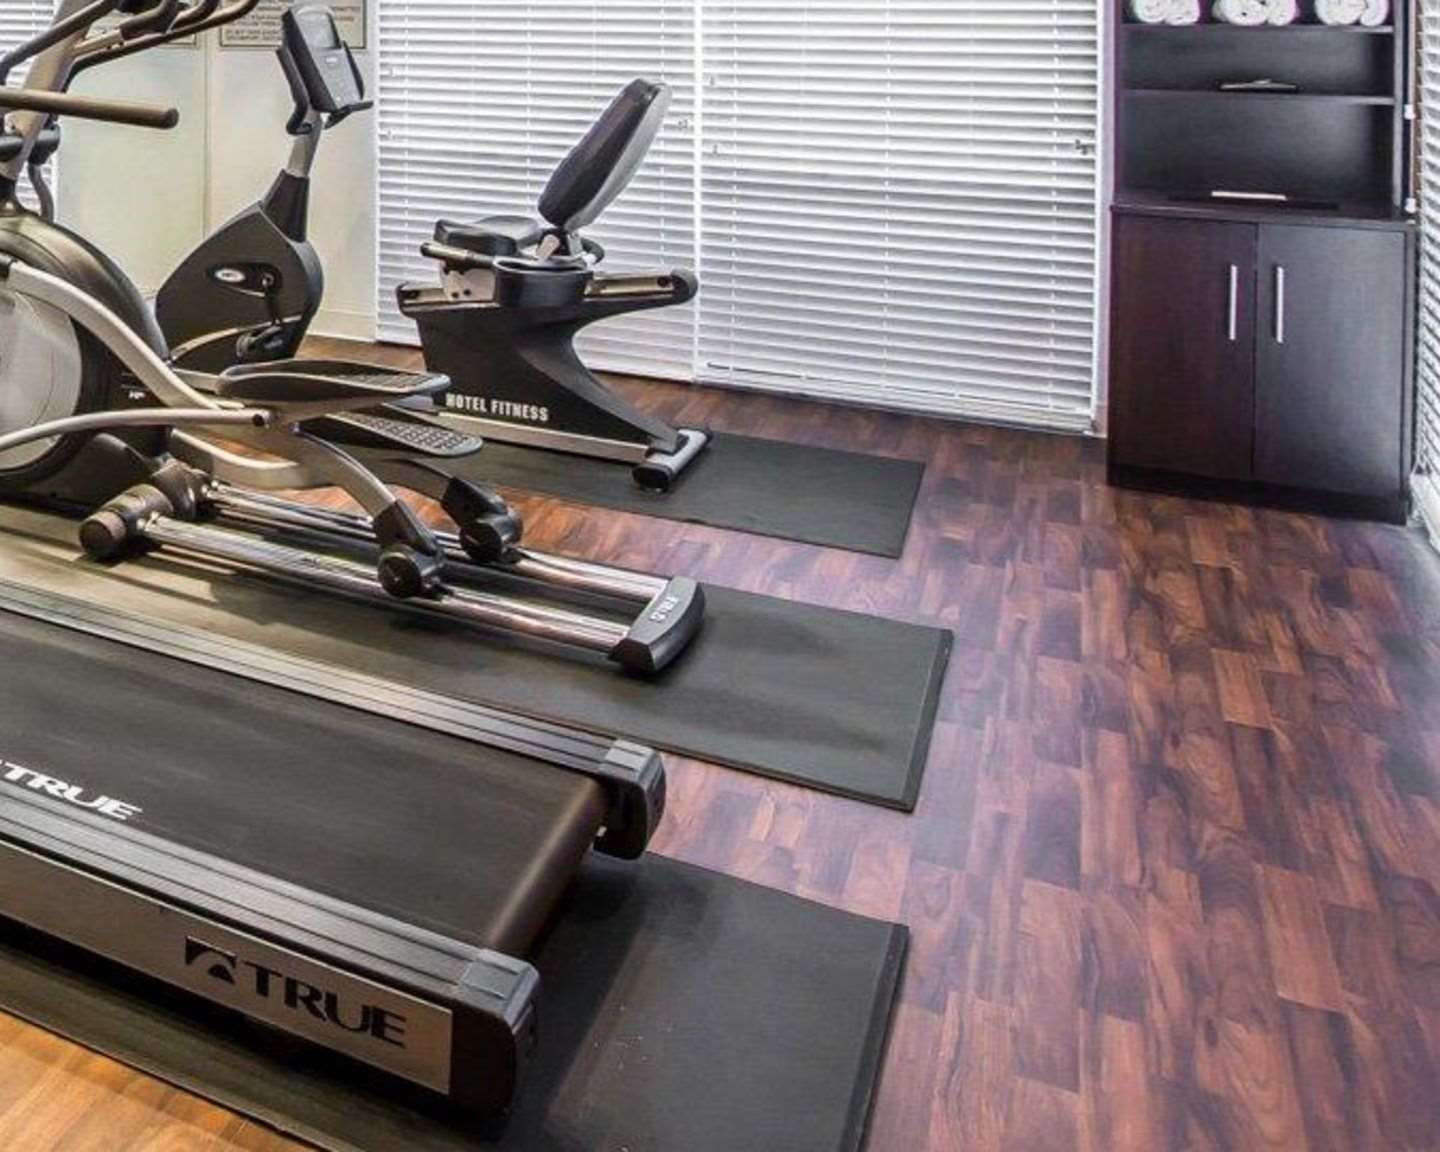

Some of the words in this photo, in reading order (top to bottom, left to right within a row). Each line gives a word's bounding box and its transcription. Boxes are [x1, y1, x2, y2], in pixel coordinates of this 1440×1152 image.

[445, 392, 488, 413] HOTEL
[491, 398, 549, 422] FITNESS
[2, 761, 143, 820] TRUE
[243, 958, 407, 1049] TRUE
